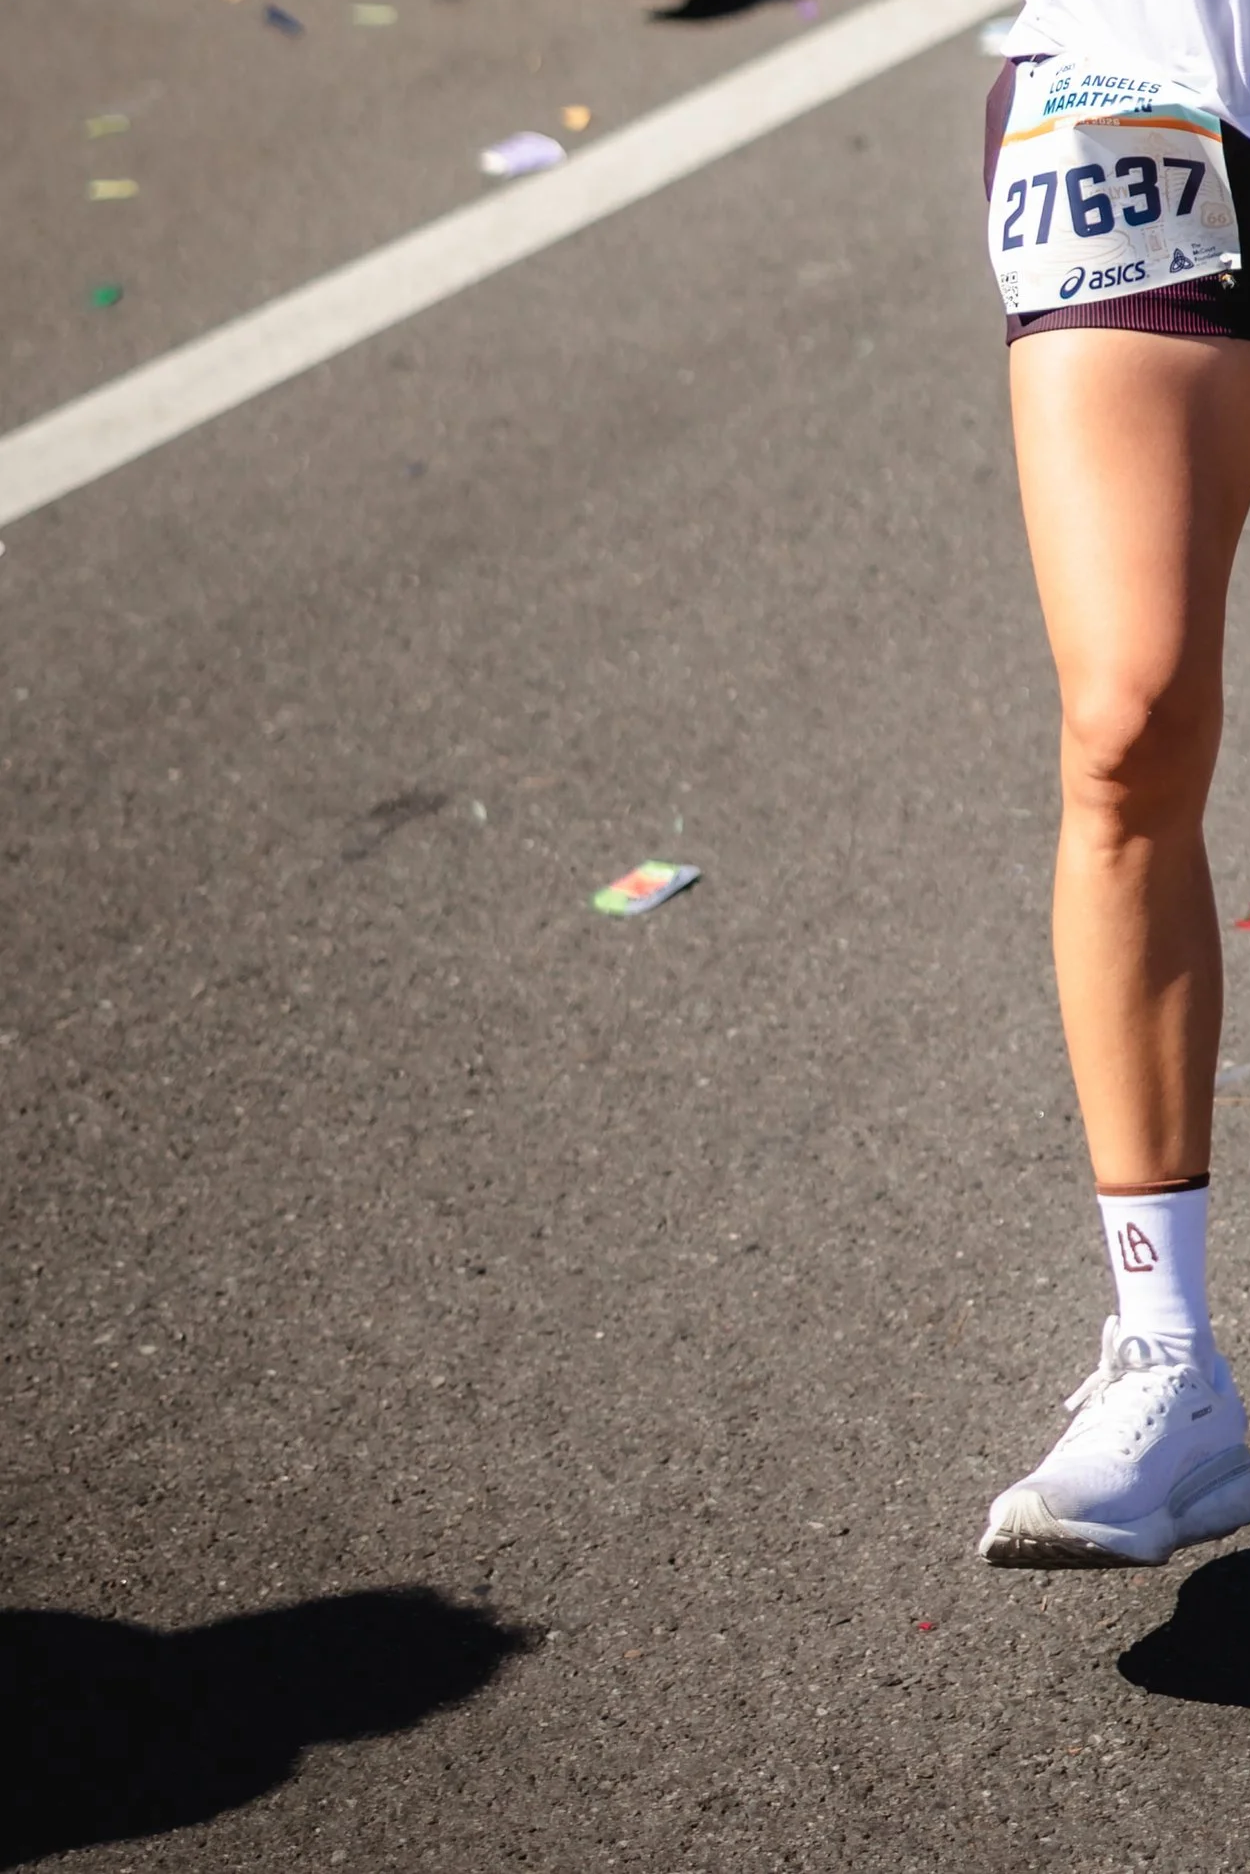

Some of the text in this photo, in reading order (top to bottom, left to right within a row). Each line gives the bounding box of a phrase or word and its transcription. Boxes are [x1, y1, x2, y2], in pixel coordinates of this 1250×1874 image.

[1049, 74, 1162, 94] LOS ANGELES
[1002, 156, 1206, 252] 27637
[1118, 1221, 1160, 1273] LA
